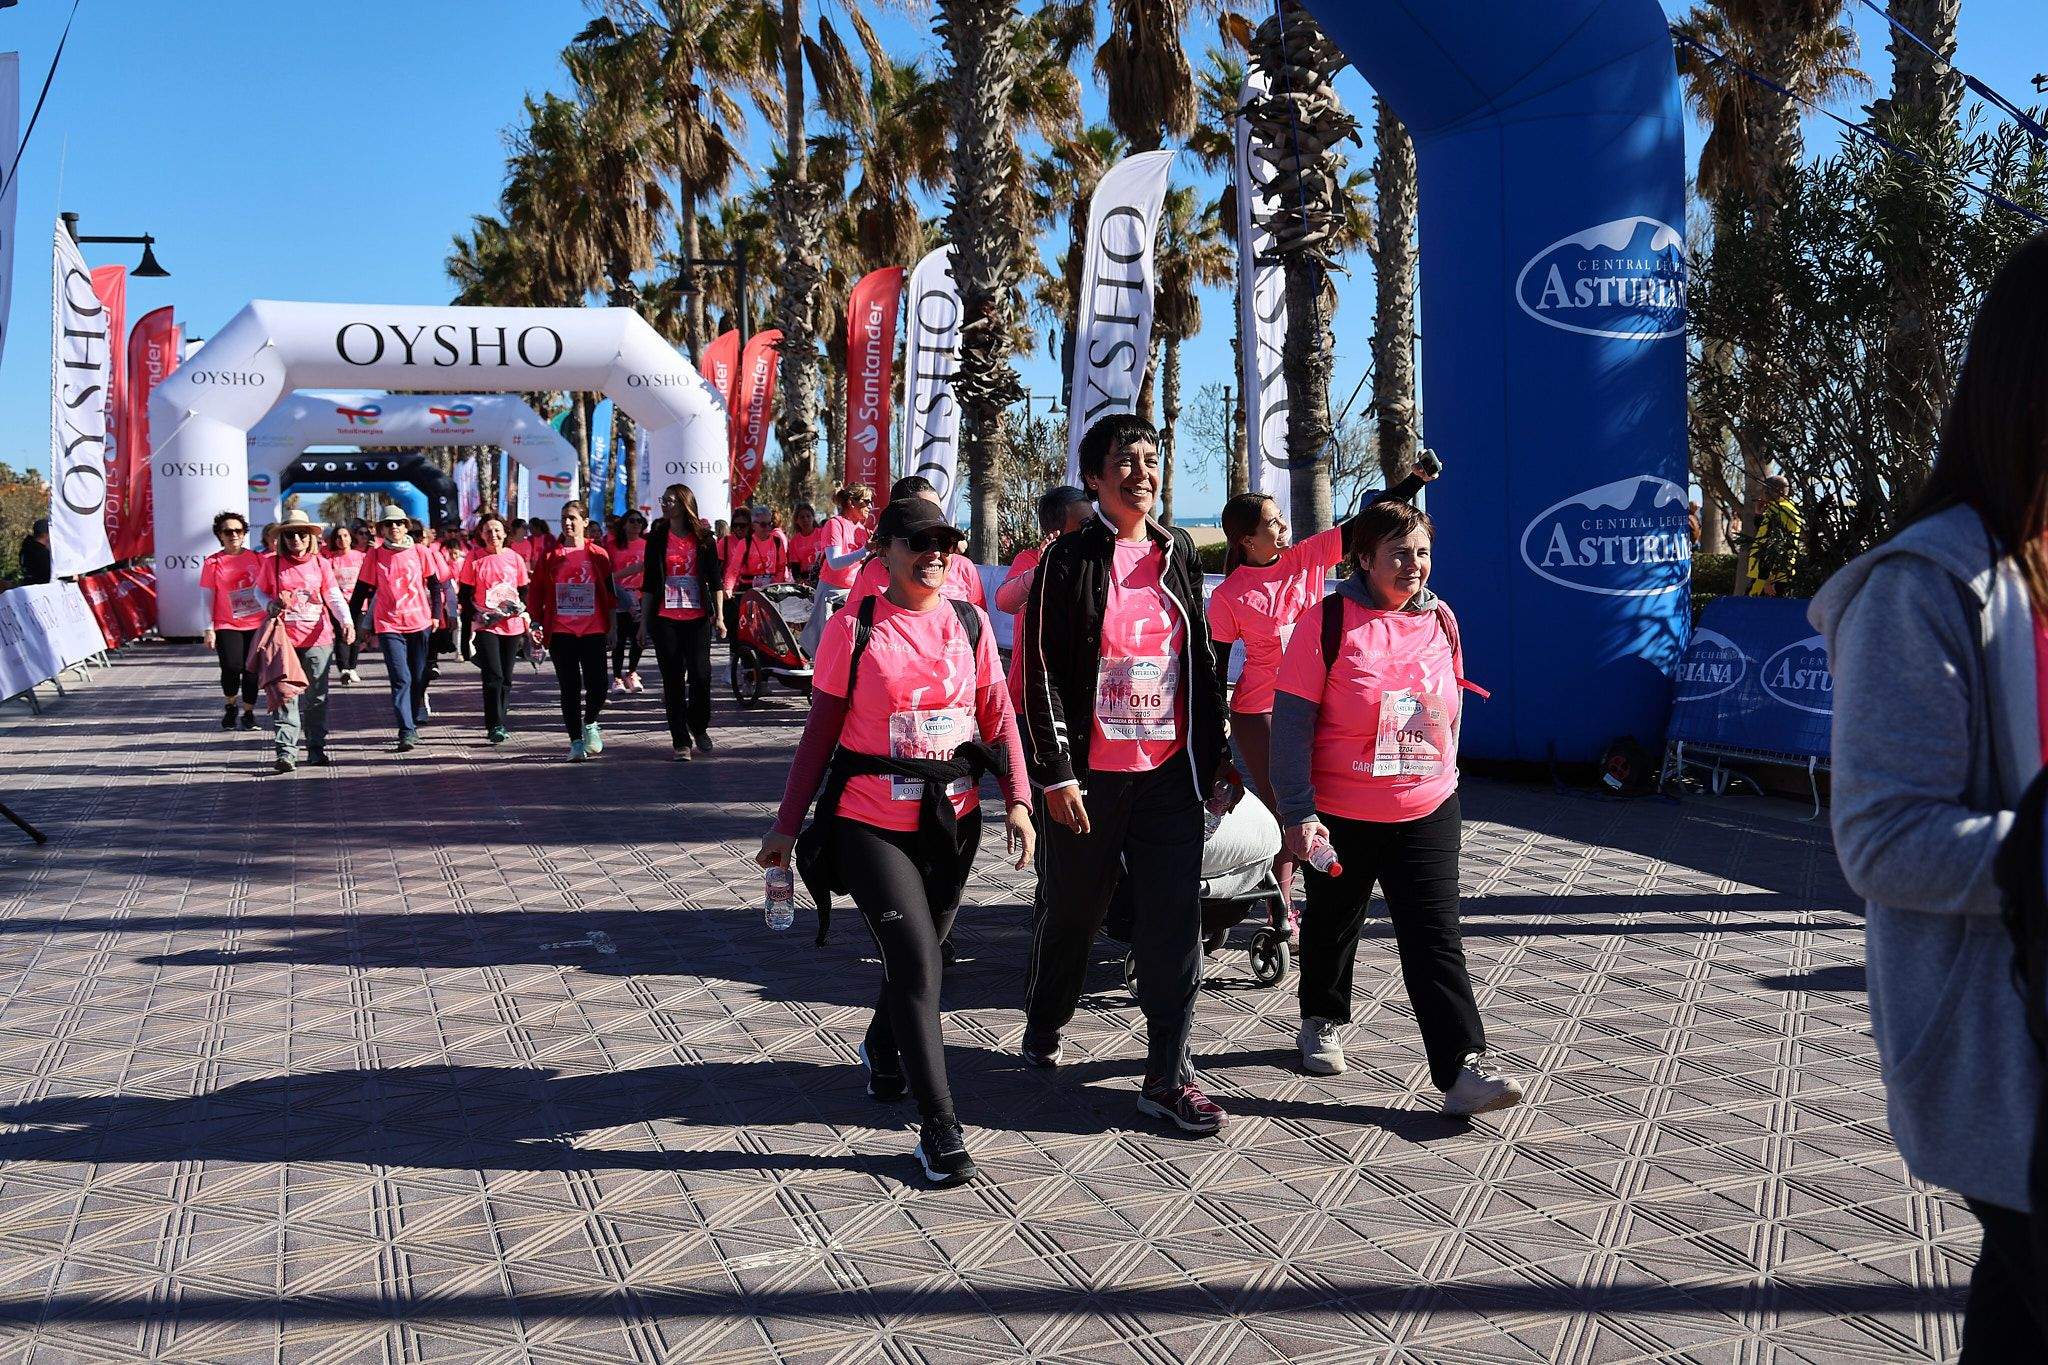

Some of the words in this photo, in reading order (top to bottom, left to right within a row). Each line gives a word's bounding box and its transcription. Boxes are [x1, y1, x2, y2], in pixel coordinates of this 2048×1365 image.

[1577, 259, 1651, 271] CENTRAL
[1084, 205, 1148, 424] YSHO
[336, 322, 563, 368] OYSHO
[859, 300, 884, 420] Santander
[191, 371, 265, 386] OYSHO
[627, 374, 690, 388] OYSHO
[63, 268, 106, 515] OYSHO
[744, 355, 769, 446] Santander
[162, 462, 230, 477] OYSHO
[301, 462, 399, 471] VOLVO
[665, 461, 723, 475] OYSHO
[1581, 517, 1653, 530] CENTRAL
[1541, 522, 1692, 566] ASTURIAN
[165, 555, 201, 570] OYS
[1675, 662, 1733, 683] RIANA
[1129, 694, 1161, 708] 016
[1395, 730, 1423, 743] 016
[902, 787, 922, 795] OYS
